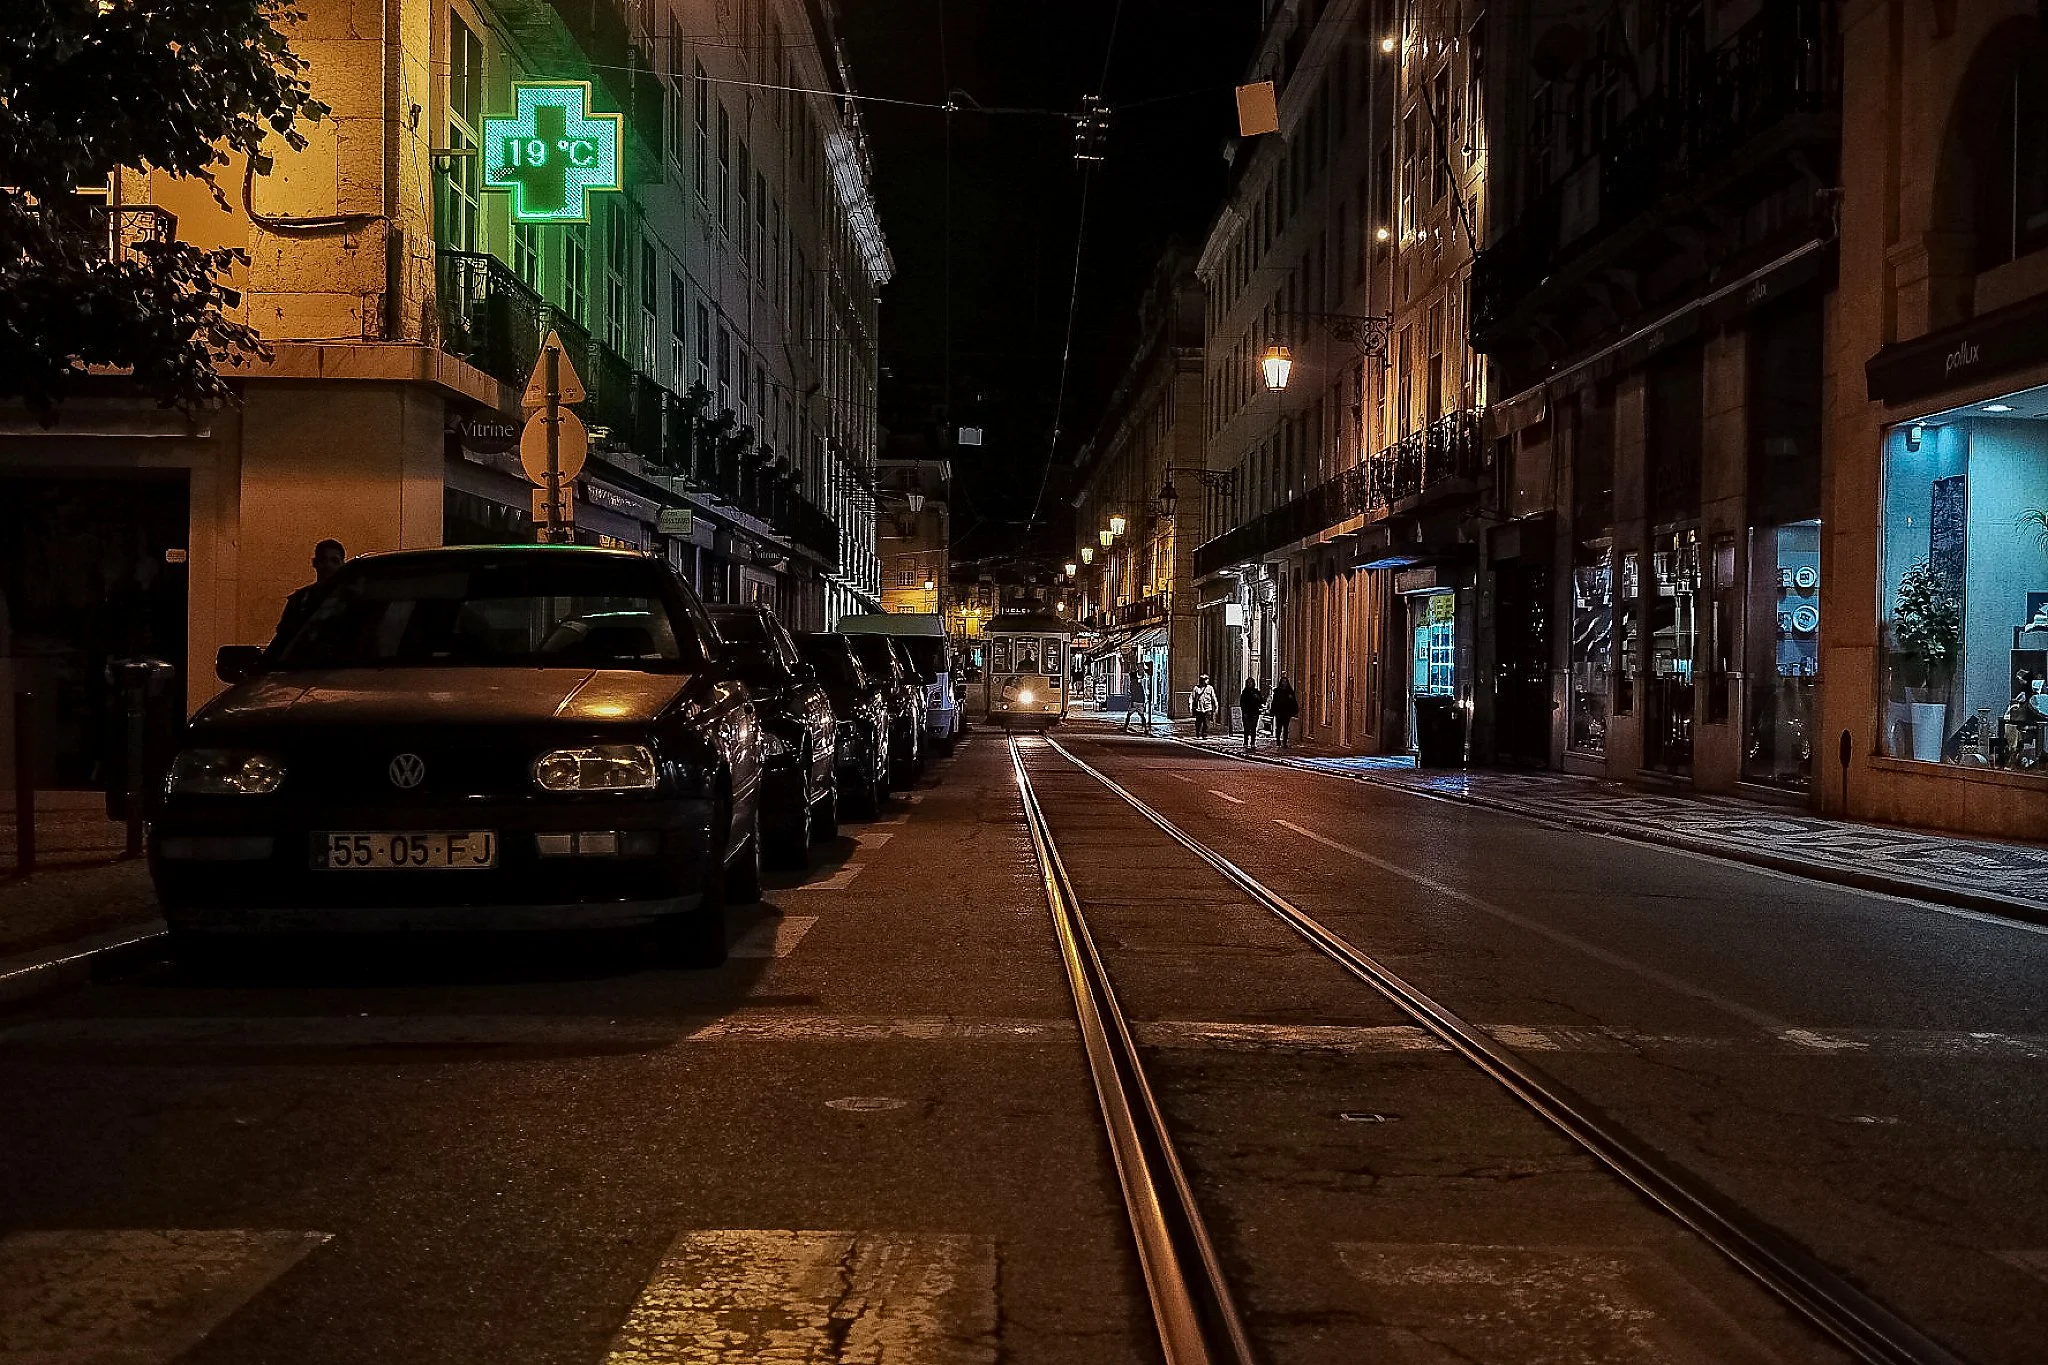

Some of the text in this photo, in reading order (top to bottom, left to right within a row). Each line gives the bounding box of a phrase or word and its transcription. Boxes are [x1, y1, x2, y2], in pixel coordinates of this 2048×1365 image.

[509, 139, 545, 167] 19
[1944, 340, 1980, 380] pollux
[460, 419, 514, 437] Vitrine
